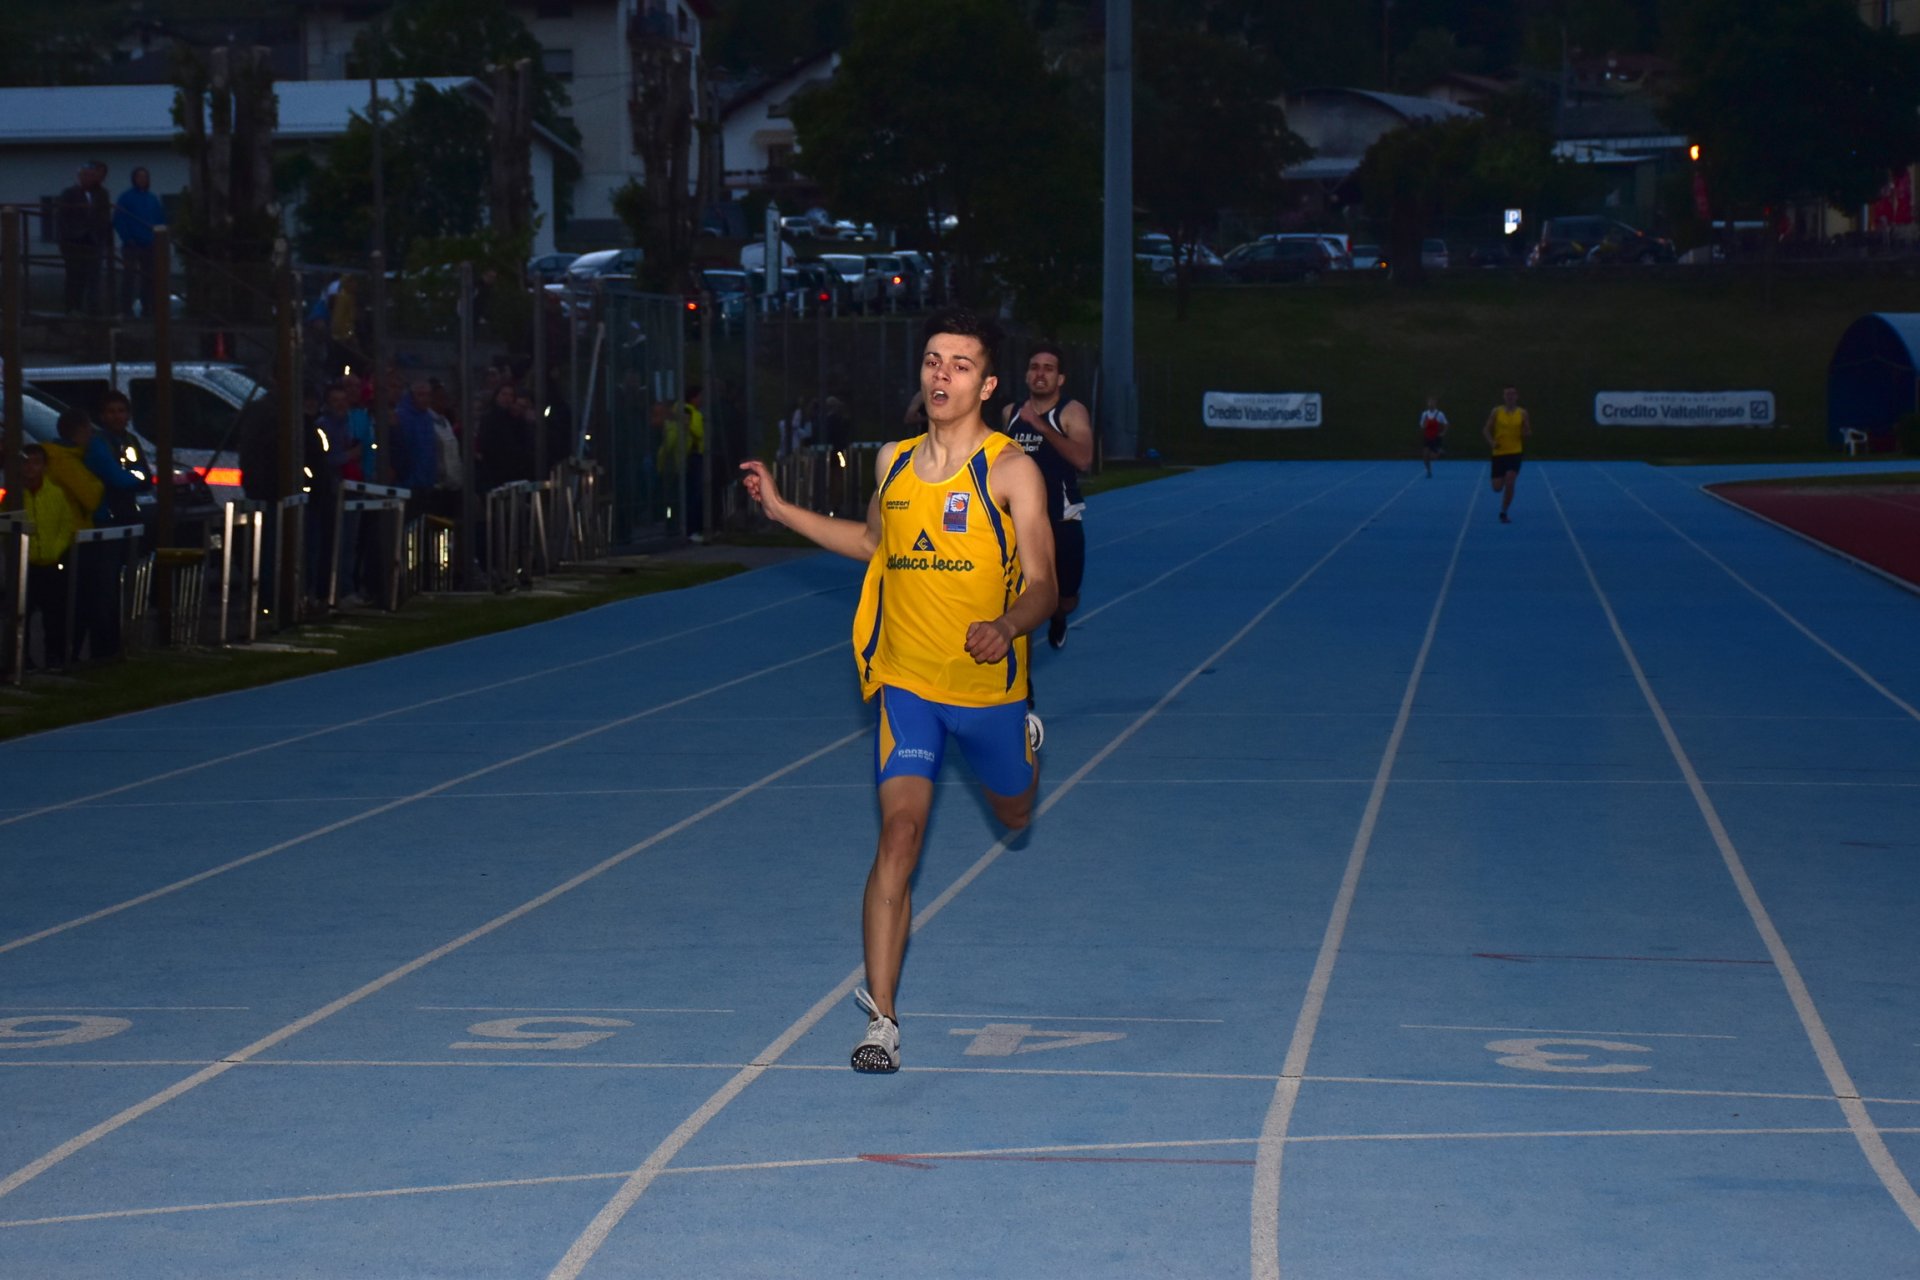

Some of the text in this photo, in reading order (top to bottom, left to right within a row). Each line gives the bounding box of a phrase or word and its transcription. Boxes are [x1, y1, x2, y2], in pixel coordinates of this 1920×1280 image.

[1602, 403, 1745, 419] Credito Valtellinese
[450, 1016, 636, 1050] 5
[949, 1023, 1127, 1056] 4
[1484, 1038, 1652, 1073] 3
